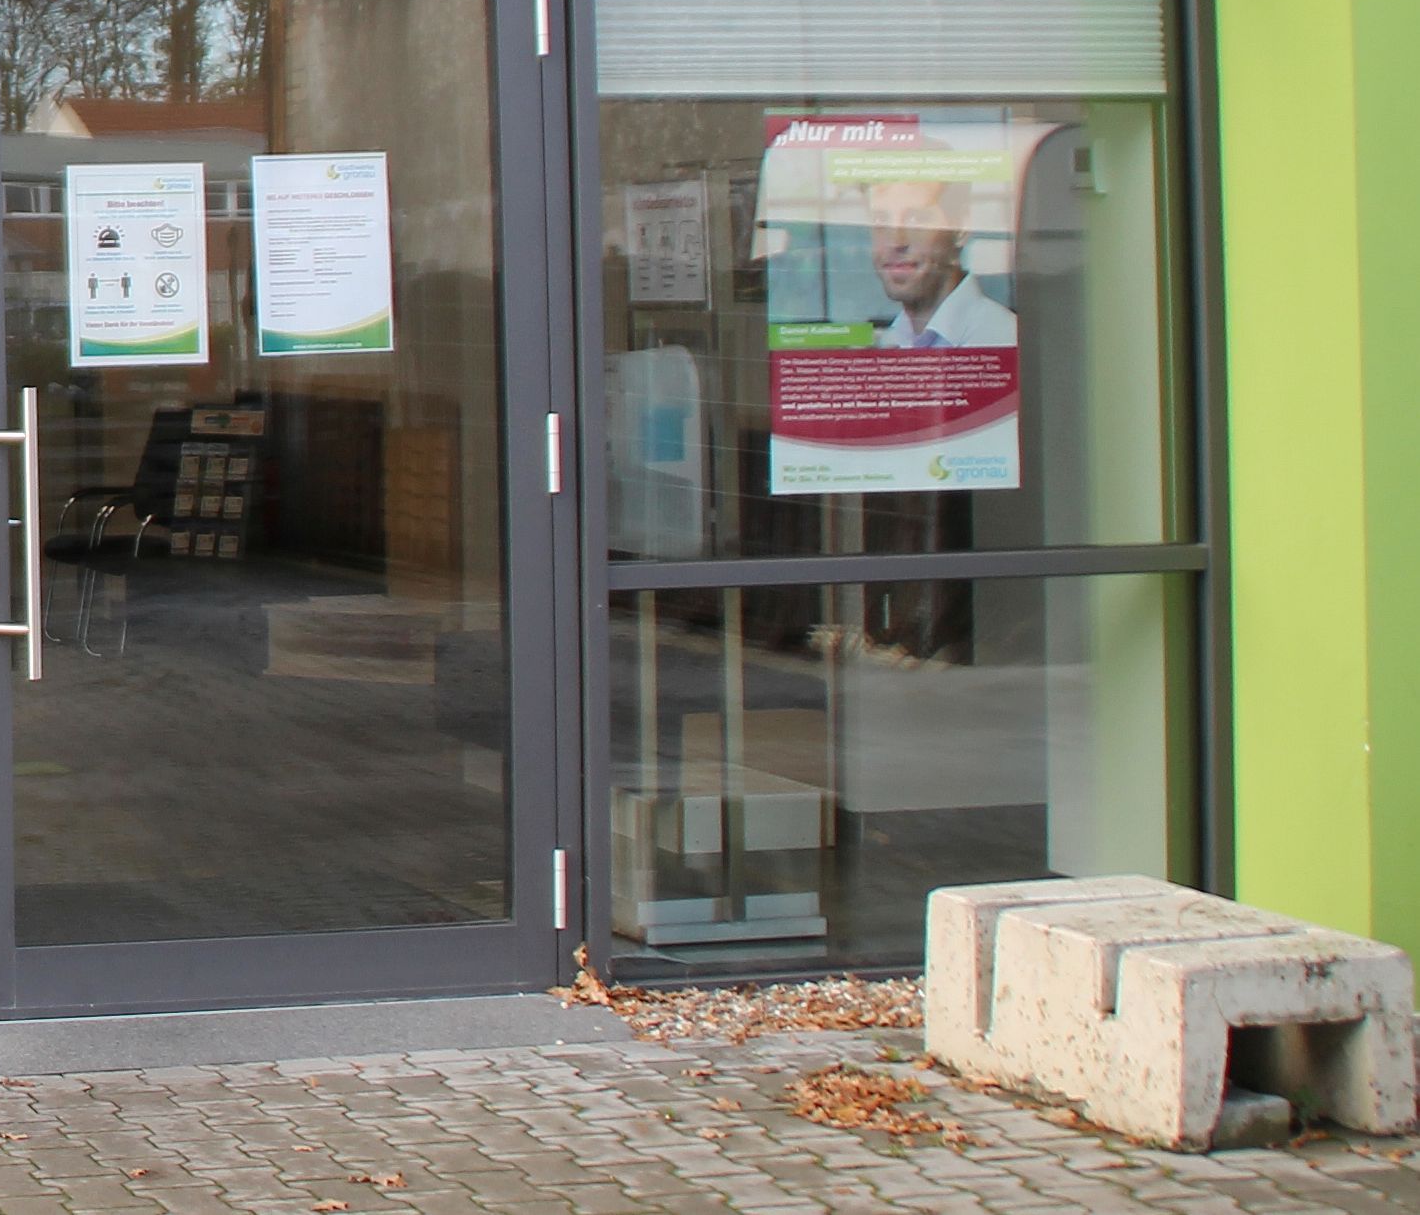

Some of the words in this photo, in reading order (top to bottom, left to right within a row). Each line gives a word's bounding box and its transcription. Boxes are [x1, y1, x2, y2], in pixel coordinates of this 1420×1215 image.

[774, 120, 836, 146] „Nur
[842, 120, 886, 141] mit
[344, 170, 376, 180] gronau
[948, 455, 1007, 466] stadtwerke
[955, 466, 1007, 480] gronau
